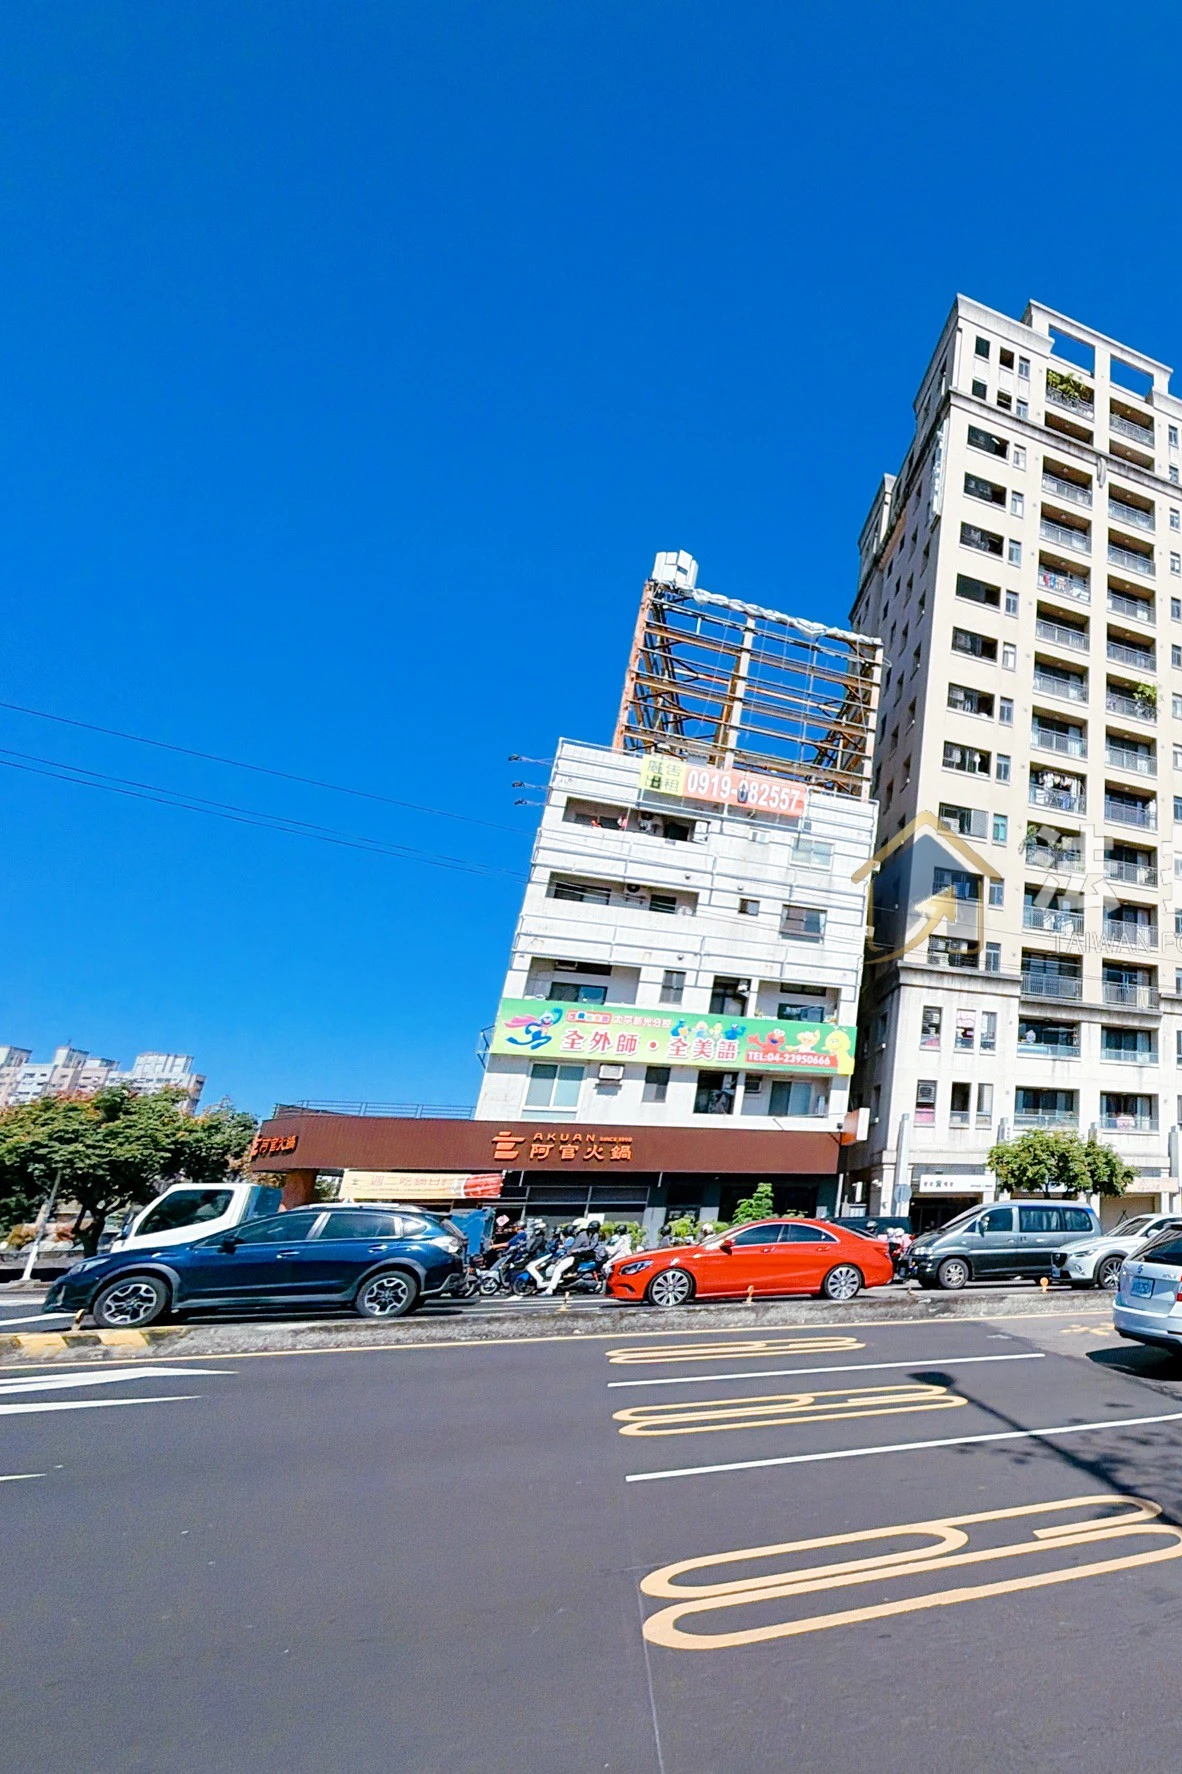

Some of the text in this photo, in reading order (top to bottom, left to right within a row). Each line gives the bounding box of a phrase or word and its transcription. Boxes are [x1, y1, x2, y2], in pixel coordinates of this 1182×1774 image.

[687, 769, 801, 812] 0919-082557
[533, 1132, 596, 1142] AKUAN
[530, 1143, 632, 1160] 阿官火鍋
